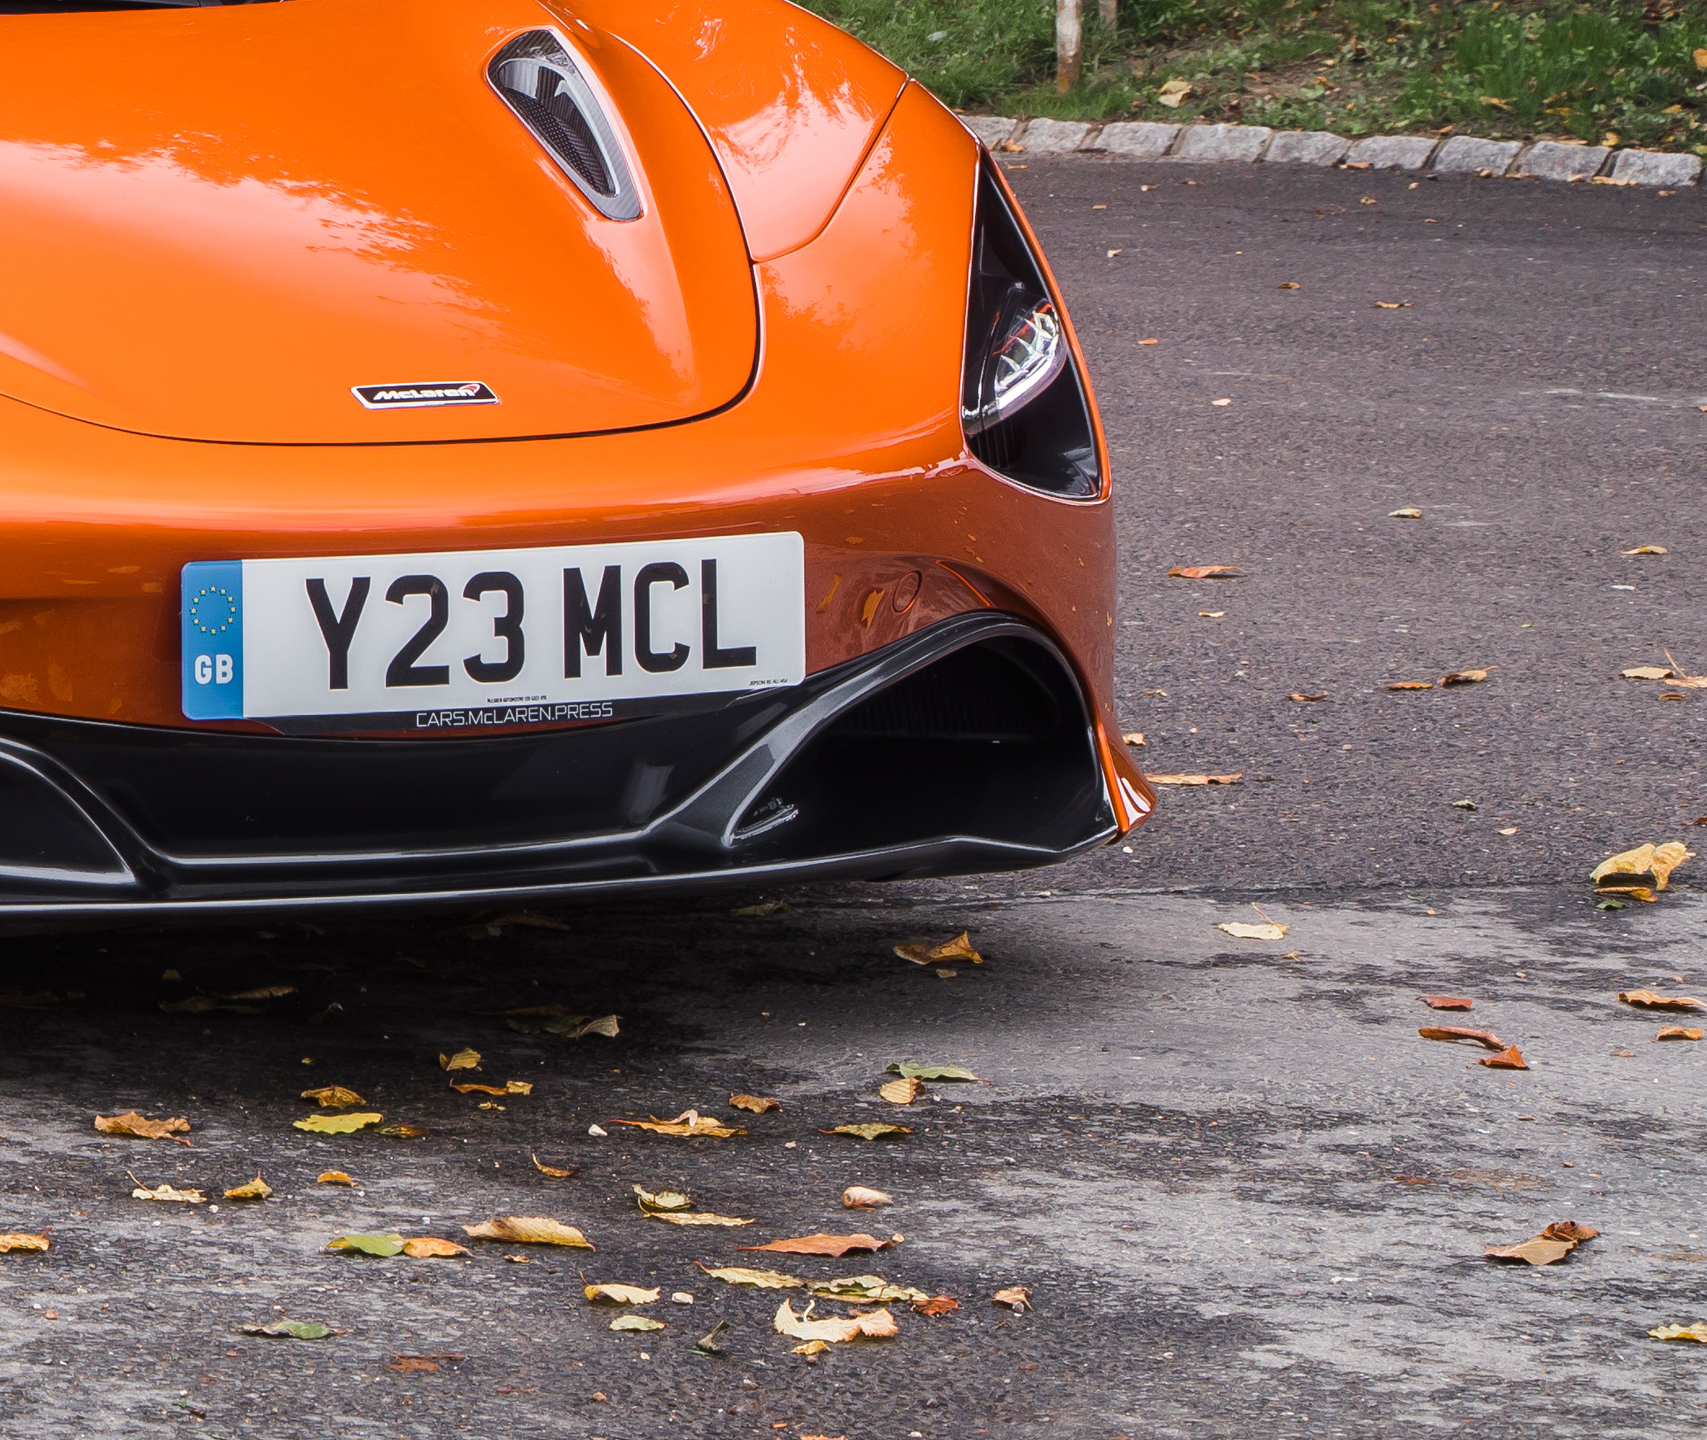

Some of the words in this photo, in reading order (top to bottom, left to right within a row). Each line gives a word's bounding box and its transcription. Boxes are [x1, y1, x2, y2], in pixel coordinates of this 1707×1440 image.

[373, 388, 476, 401] McLaren
[305, 571, 526, 691] Y23
[563, 558, 757, 679] MCL
[194, 654, 234, 685] GB
[415, 701, 614, 728] CARS.McLAREN.PRESS
